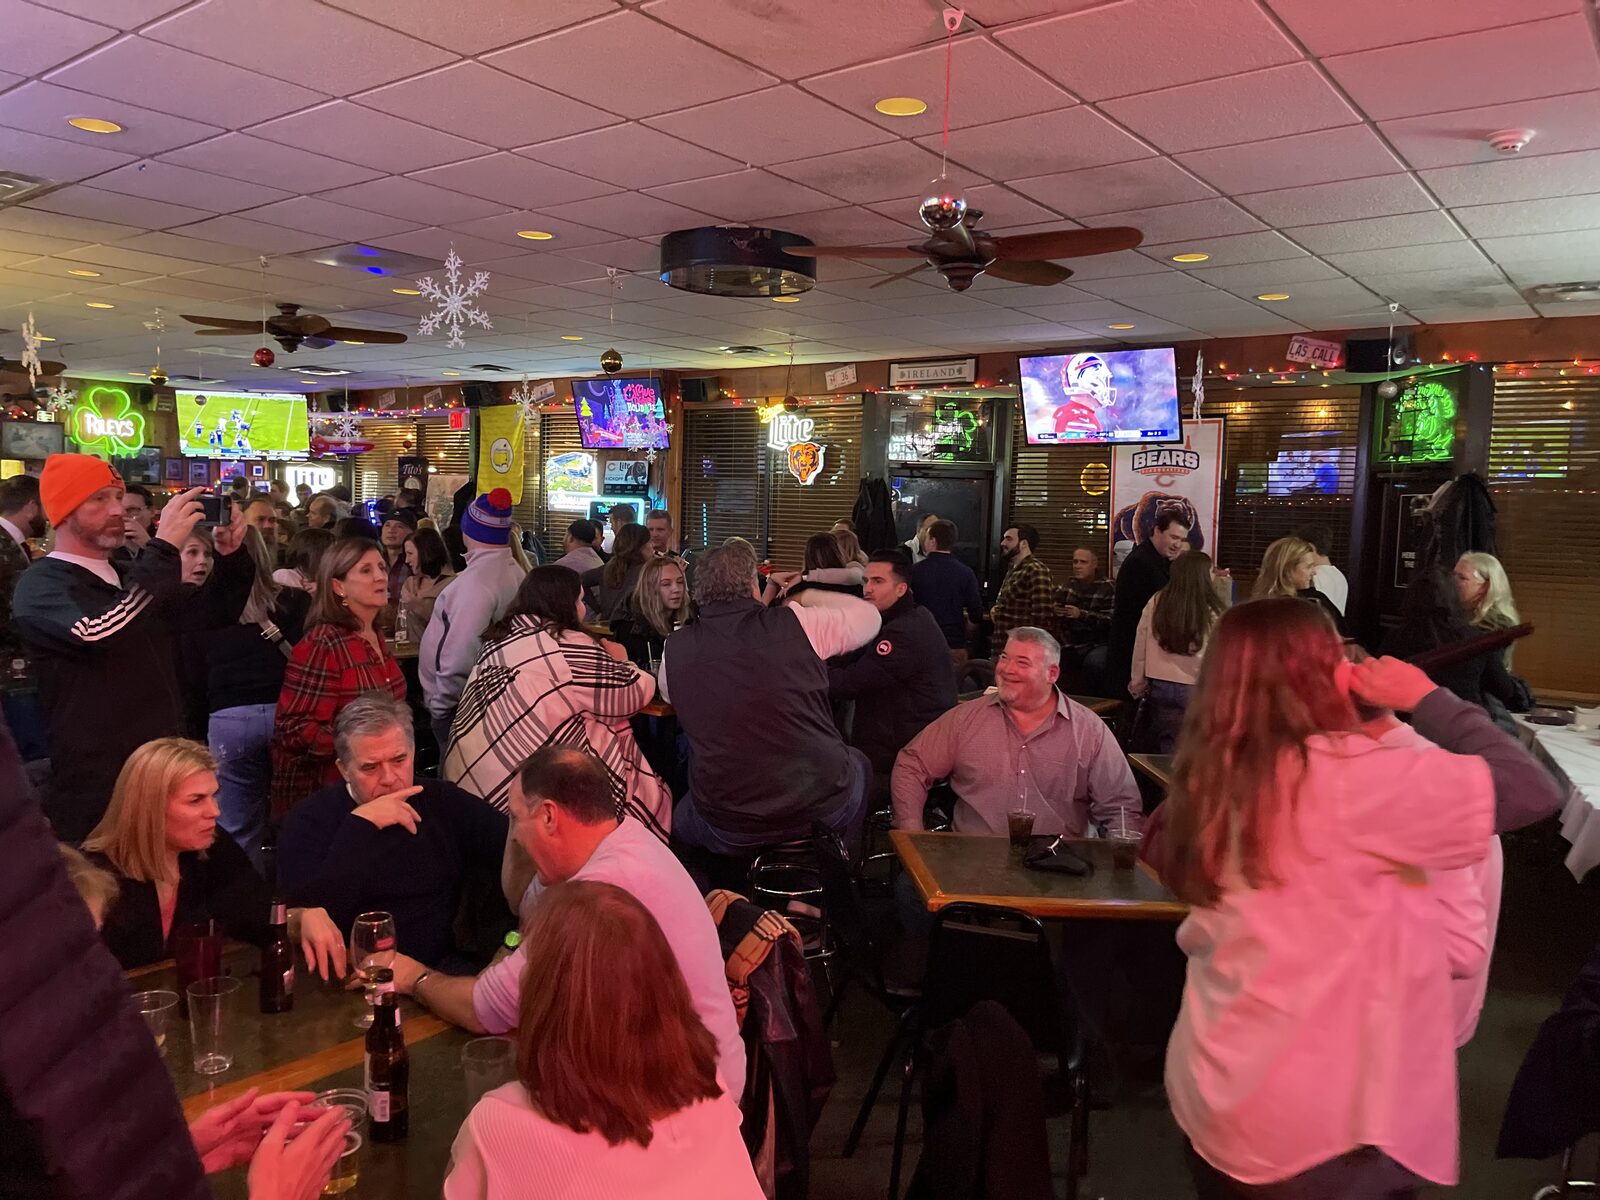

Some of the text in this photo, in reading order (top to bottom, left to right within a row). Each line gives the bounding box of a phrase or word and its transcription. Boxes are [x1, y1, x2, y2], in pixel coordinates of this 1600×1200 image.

[1288, 342, 1336, 362] LAS CALL
[907, 368, 956, 379] IRELAND
[766, 415, 814, 452] Lite
[403, 463, 423, 475] Tito's
[1133, 451, 1199, 470] BEARS
